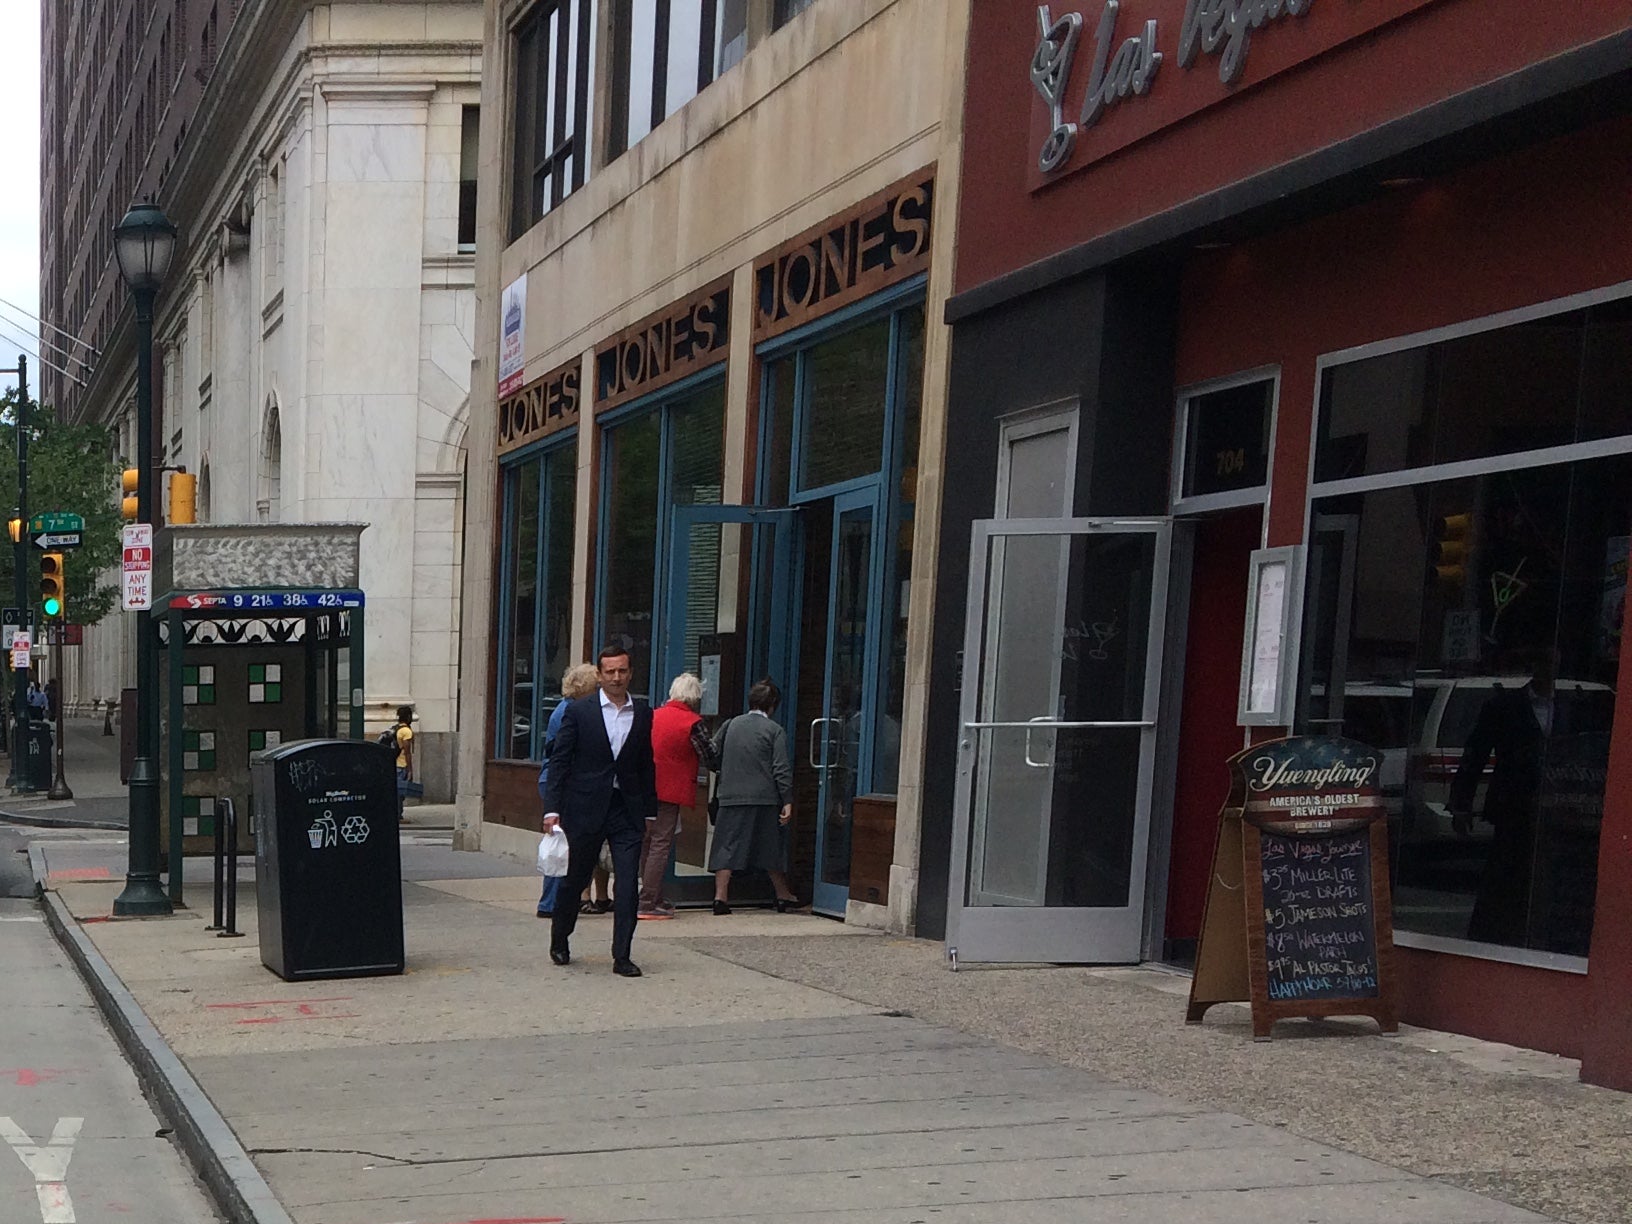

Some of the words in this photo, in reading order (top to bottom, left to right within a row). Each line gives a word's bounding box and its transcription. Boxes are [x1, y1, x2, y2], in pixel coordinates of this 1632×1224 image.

[760, 187, 927, 322] JONES
[607, 299, 717, 395] JONES
[500, 371, 579, 446] JONES
[1217, 448, 1244, 474] 704
[132, 549, 143, 560] NO
[129, 574, 146, 584] ANY
[128, 586, 147, 596] TIME
[203, 597, 227, 605] SEPTA
[233, 595, 243, 607] 9
[251, 595, 268, 607] 21
[283, 595, 300, 607] 38
[318, 594, 335, 606] 42
[1250, 757, 1376, 791] Yuengling
[329, 795, 366, 803] COMPACTOR
[1270, 795, 1321, 807] AMERICA'S
[1325, 793, 1360, 805] OLDEST
[1290, 805, 1335, 817] BREWERY
[1265, 907, 1286, 929] $5
[1288, 904, 1338, 925] JAMESON
[1293, 960, 1306, 979] AL
[1308, 960, 1343, 975] PASTOR
